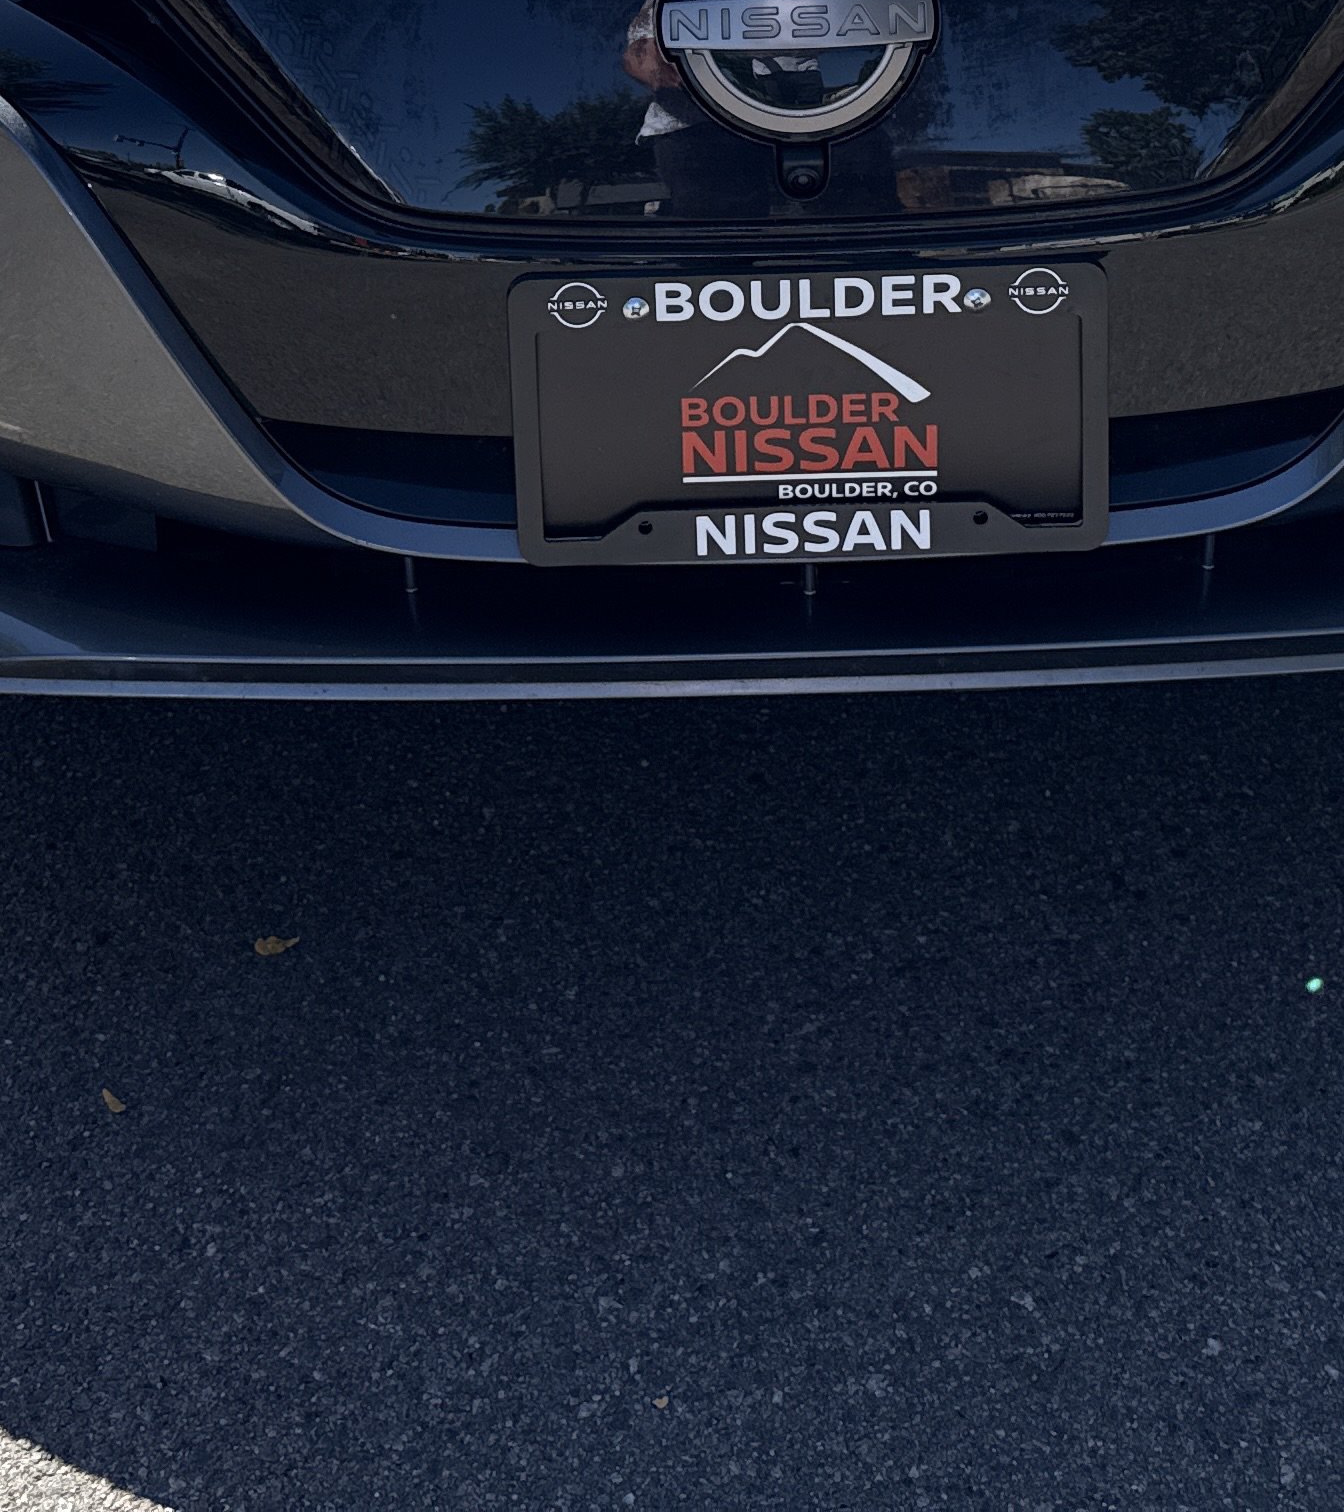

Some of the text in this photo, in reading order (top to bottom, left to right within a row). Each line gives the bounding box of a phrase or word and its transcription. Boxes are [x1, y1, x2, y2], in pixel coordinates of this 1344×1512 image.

[669, 1, 927, 41] NISSAN
[547, 300, 607, 310] NISSAN
[655, 274, 962, 322] BOULDER
[1008, 286, 1069, 296] NISSAN
[681, 392, 900, 427] BOULDER
[682, 424, 938, 473] NISSAN
[778, 480, 938, 499] BOULDER, CO
[696, 509, 931, 556] NISSAN
